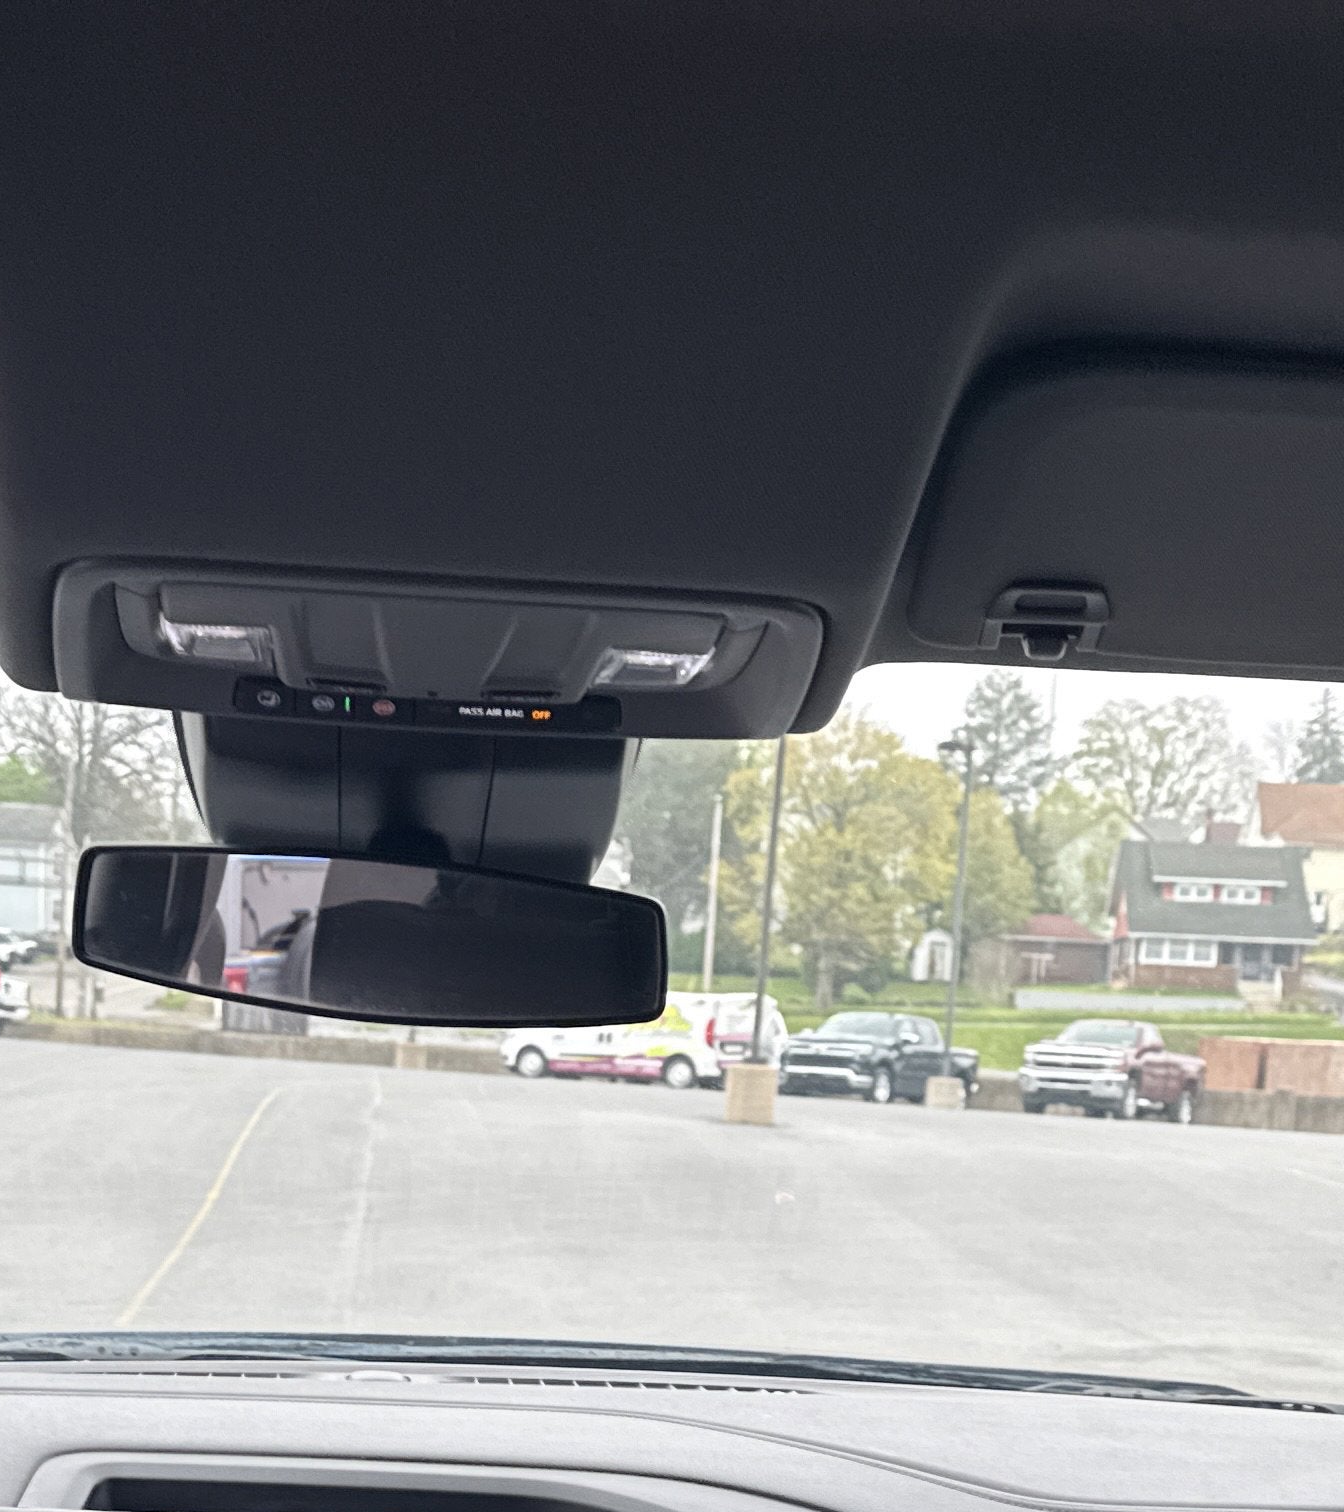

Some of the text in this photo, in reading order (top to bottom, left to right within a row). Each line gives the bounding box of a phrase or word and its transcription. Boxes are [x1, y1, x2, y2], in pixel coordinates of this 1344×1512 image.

[459, 707, 484, 717] PASS
[486, 708, 502, 717] AIR
[532, 710, 551, 720] OFF
